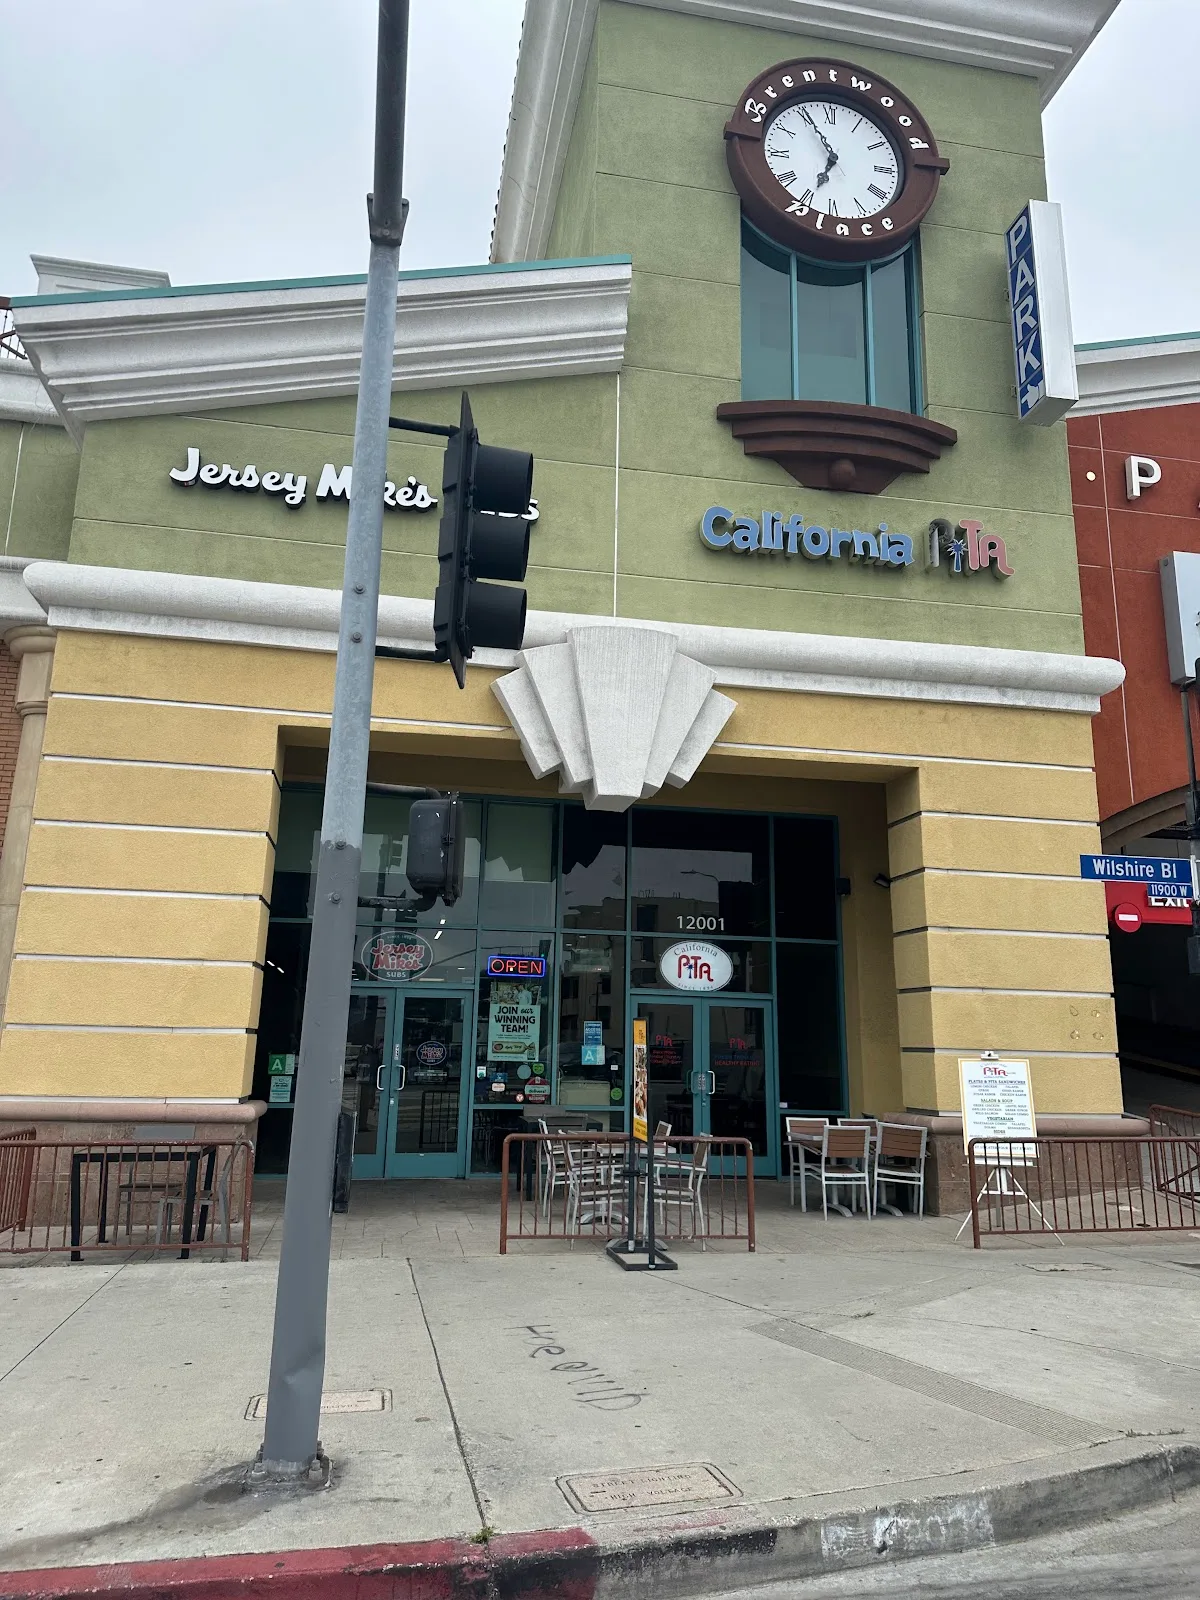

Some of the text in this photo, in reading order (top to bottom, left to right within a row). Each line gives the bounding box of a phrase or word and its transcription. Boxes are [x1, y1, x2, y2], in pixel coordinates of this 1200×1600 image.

[745, 69, 929, 149] Brentwood
[785, 200, 894, 236] Place
[1009, 215, 1041, 384] PARK
[169, 447, 438, 508] Jersey Mke's
[702, 506, 915, 566] California
[1093, 858, 1177, 878] Wilshire Bl
[1151, 884, 1187, 896] 11900 W
[677, 916, 725, 931] 12001
[371, 939, 425, 959] Jersey
[674, 943, 718, 957] California
[491, 959, 542, 974] OPEN
[497, 1006, 519, 1015] JOIN
[494, 1014, 536, 1024] WINNING
[501, 1024, 529, 1033] TEAM!
[585, 1050, 595, 1061] A
[271, 1058, 283, 1071] A
